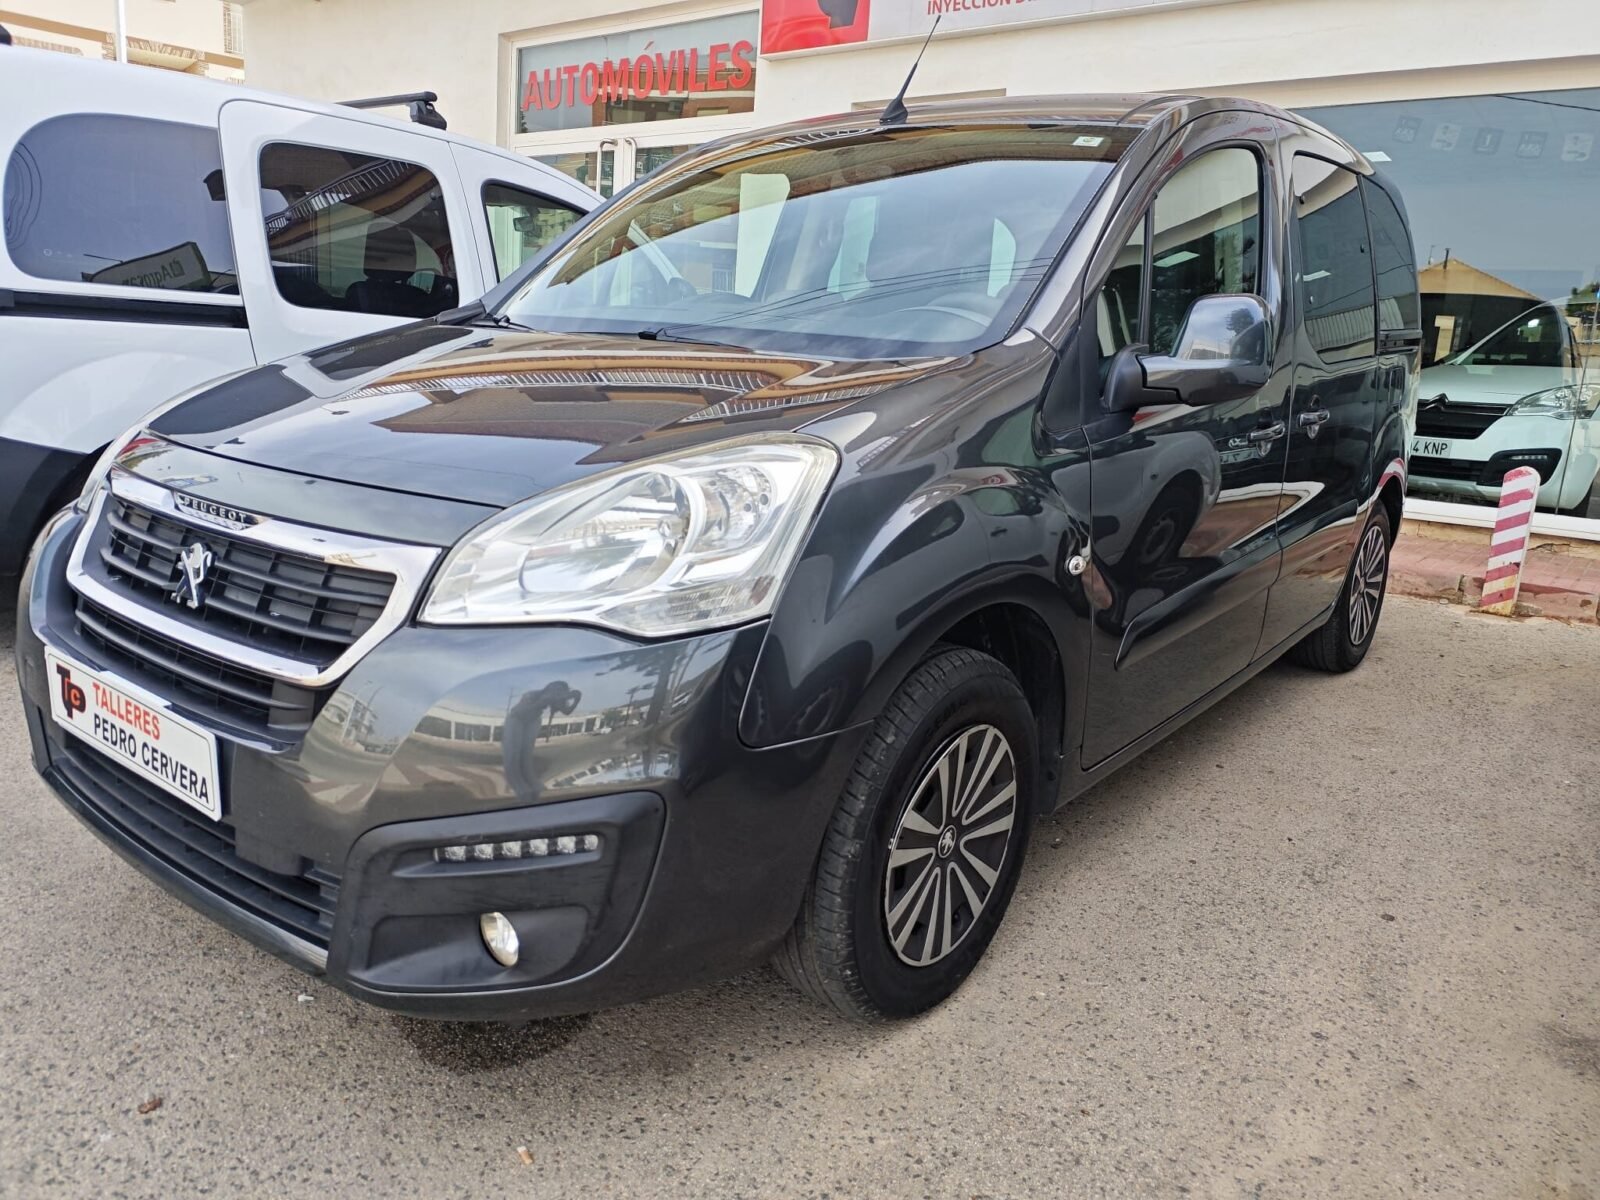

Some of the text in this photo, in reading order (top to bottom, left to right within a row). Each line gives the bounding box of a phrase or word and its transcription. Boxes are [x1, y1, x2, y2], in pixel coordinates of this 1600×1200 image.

[522, 40, 754, 111] AUTOMÓVILES
[1423, 441, 1448, 455] KNP
[184, 497, 247, 523] PEUGEOT
[92, 681, 161, 741] TALLERES
[93, 712, 210, 804] PEDRO CERVERA
